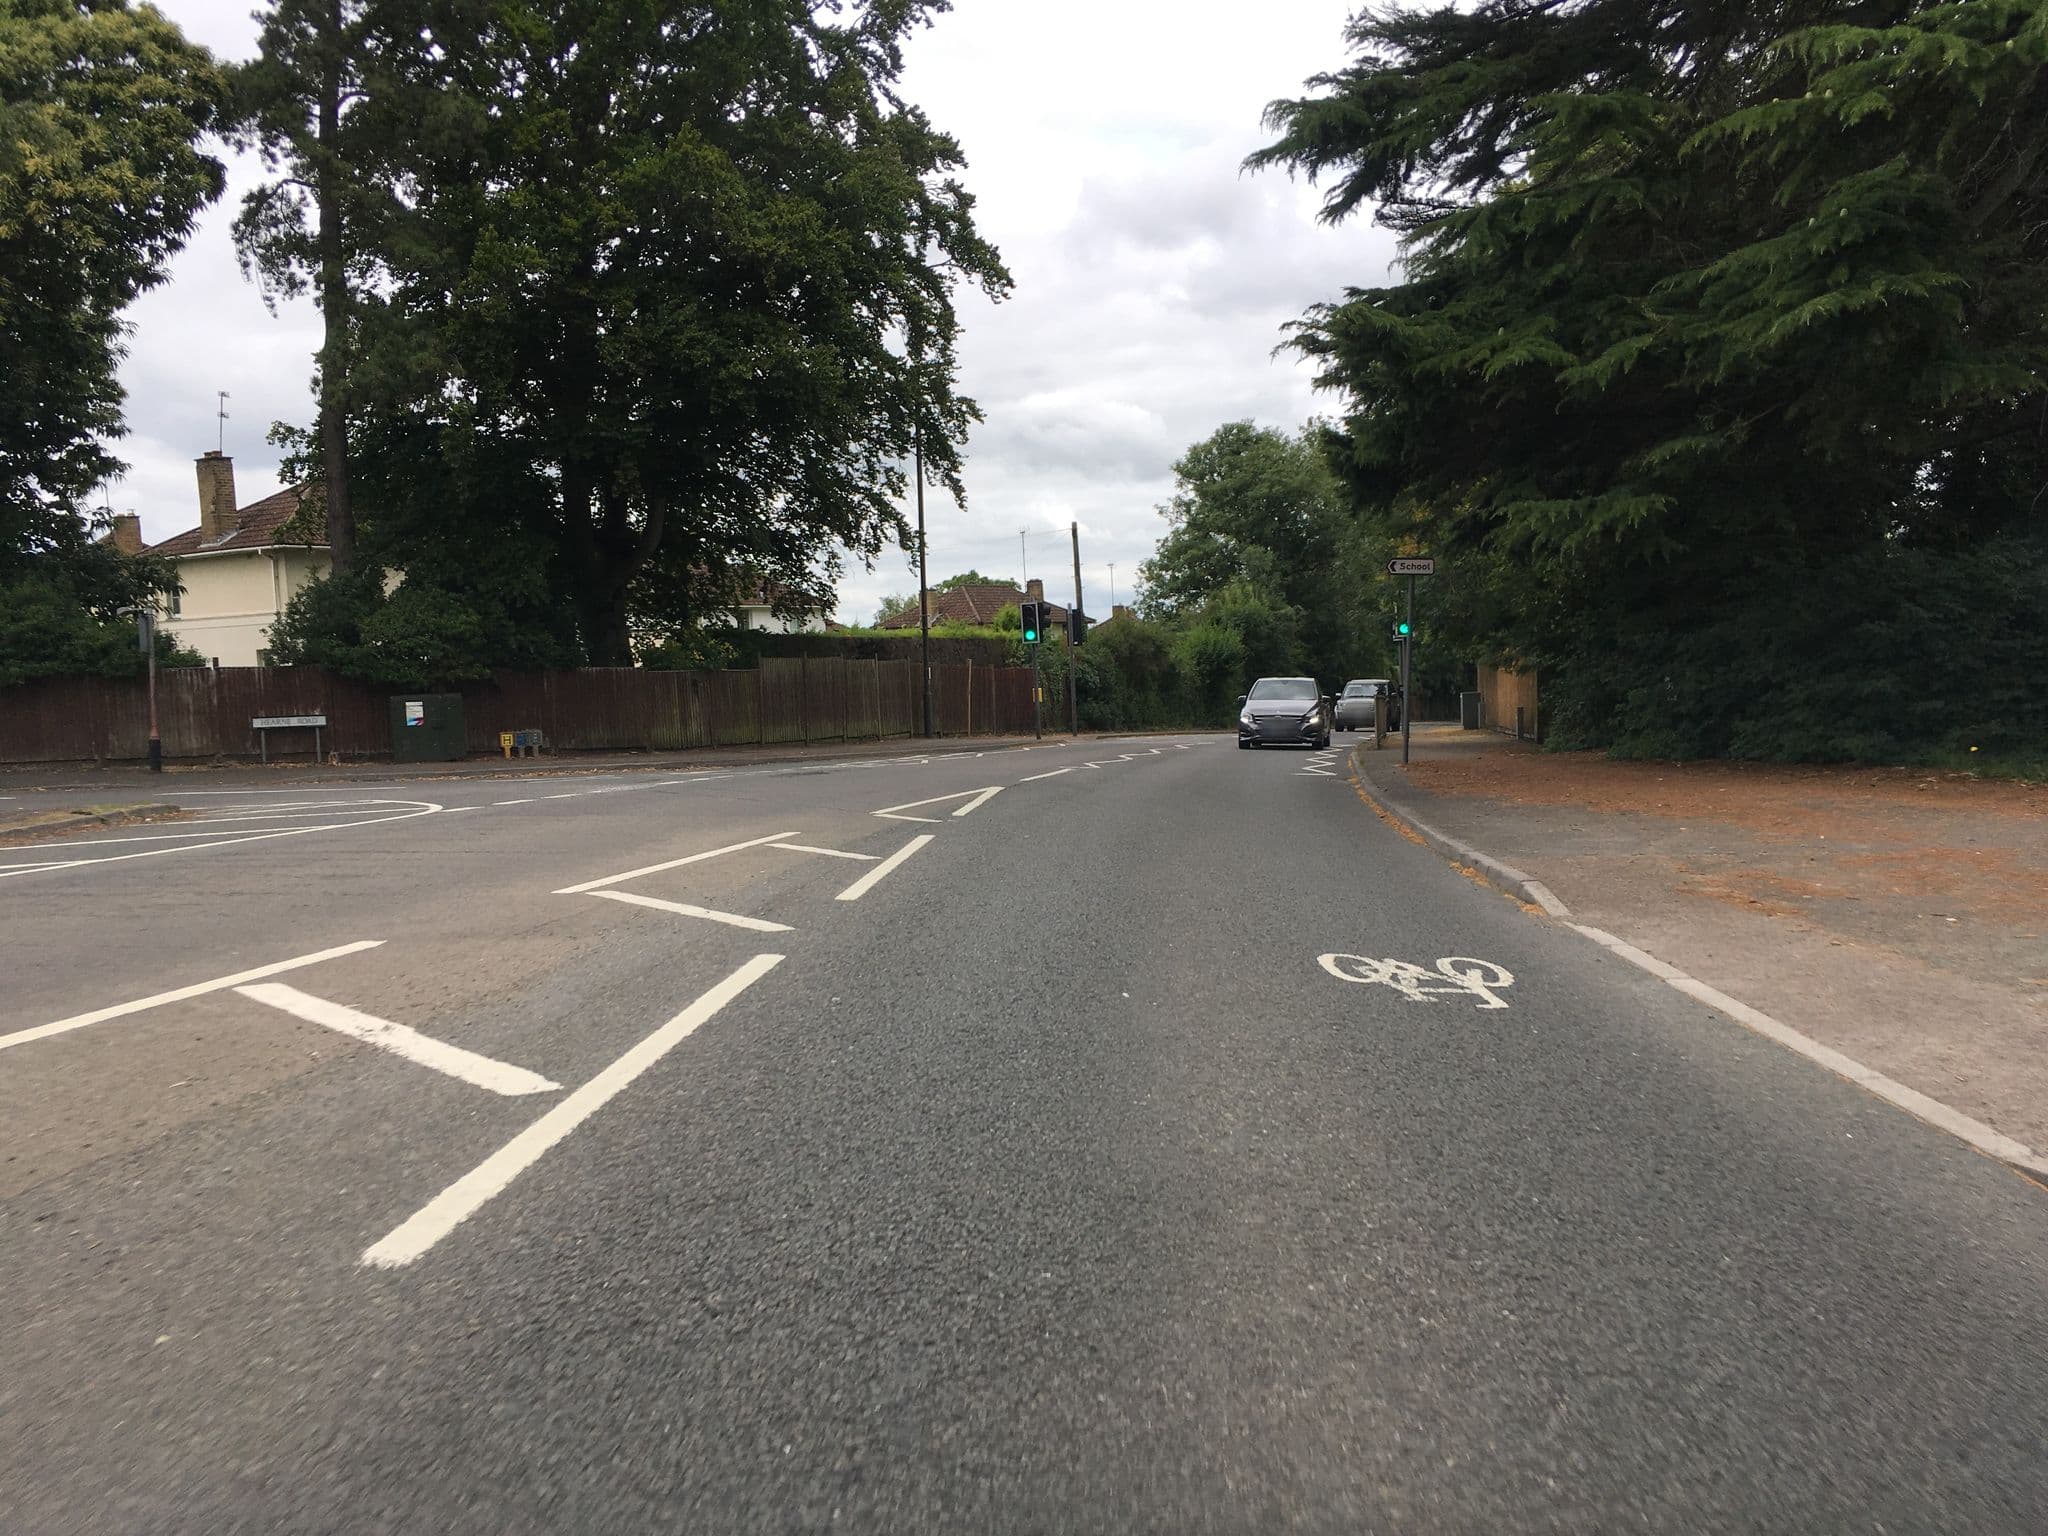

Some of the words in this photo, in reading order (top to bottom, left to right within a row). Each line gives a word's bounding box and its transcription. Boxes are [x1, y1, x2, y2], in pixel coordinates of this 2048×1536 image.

[1399, 562, 1430, 570] School
[297, 717, 318, 725] ROAD
[502, 735, 512, 745] H
